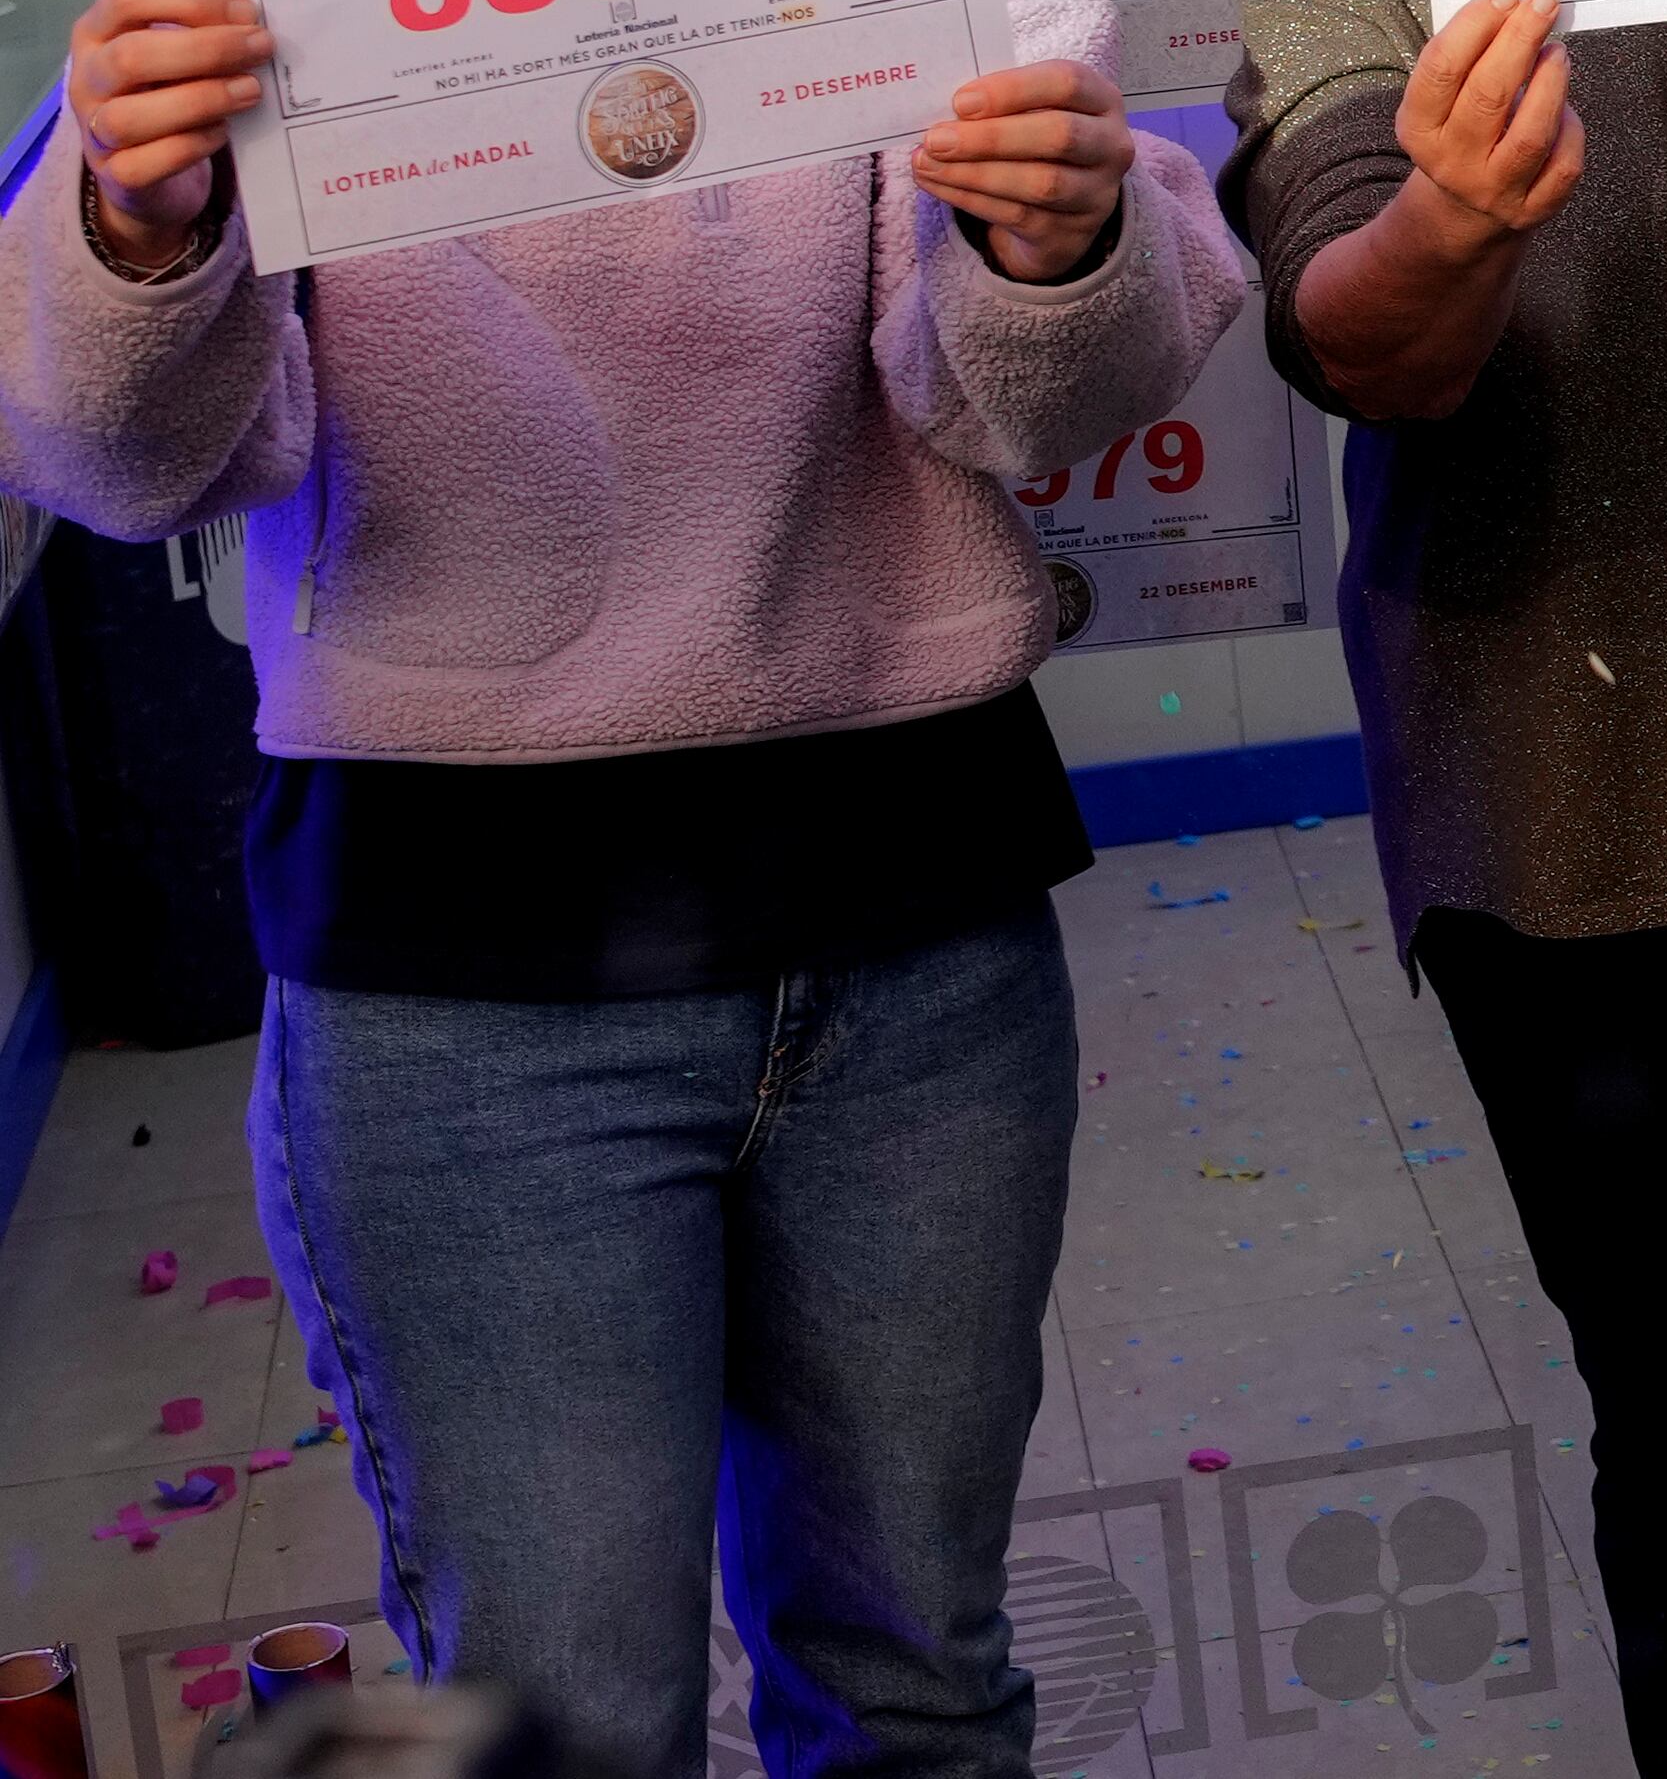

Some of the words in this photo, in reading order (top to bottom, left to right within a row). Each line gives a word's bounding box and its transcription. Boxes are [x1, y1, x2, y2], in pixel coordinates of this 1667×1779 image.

[760, 89, 786, 107] 22
[795, 63, 917, 100] DESEMBRE
[324, 162, 422, 195] LOTERIA
[426, 159, 450, 176] de
[453, 141, 534, 170] NADAL
[1139, 585, 1159, 600] 22
[1165, 575, 1259, 598] DESEMBRE
